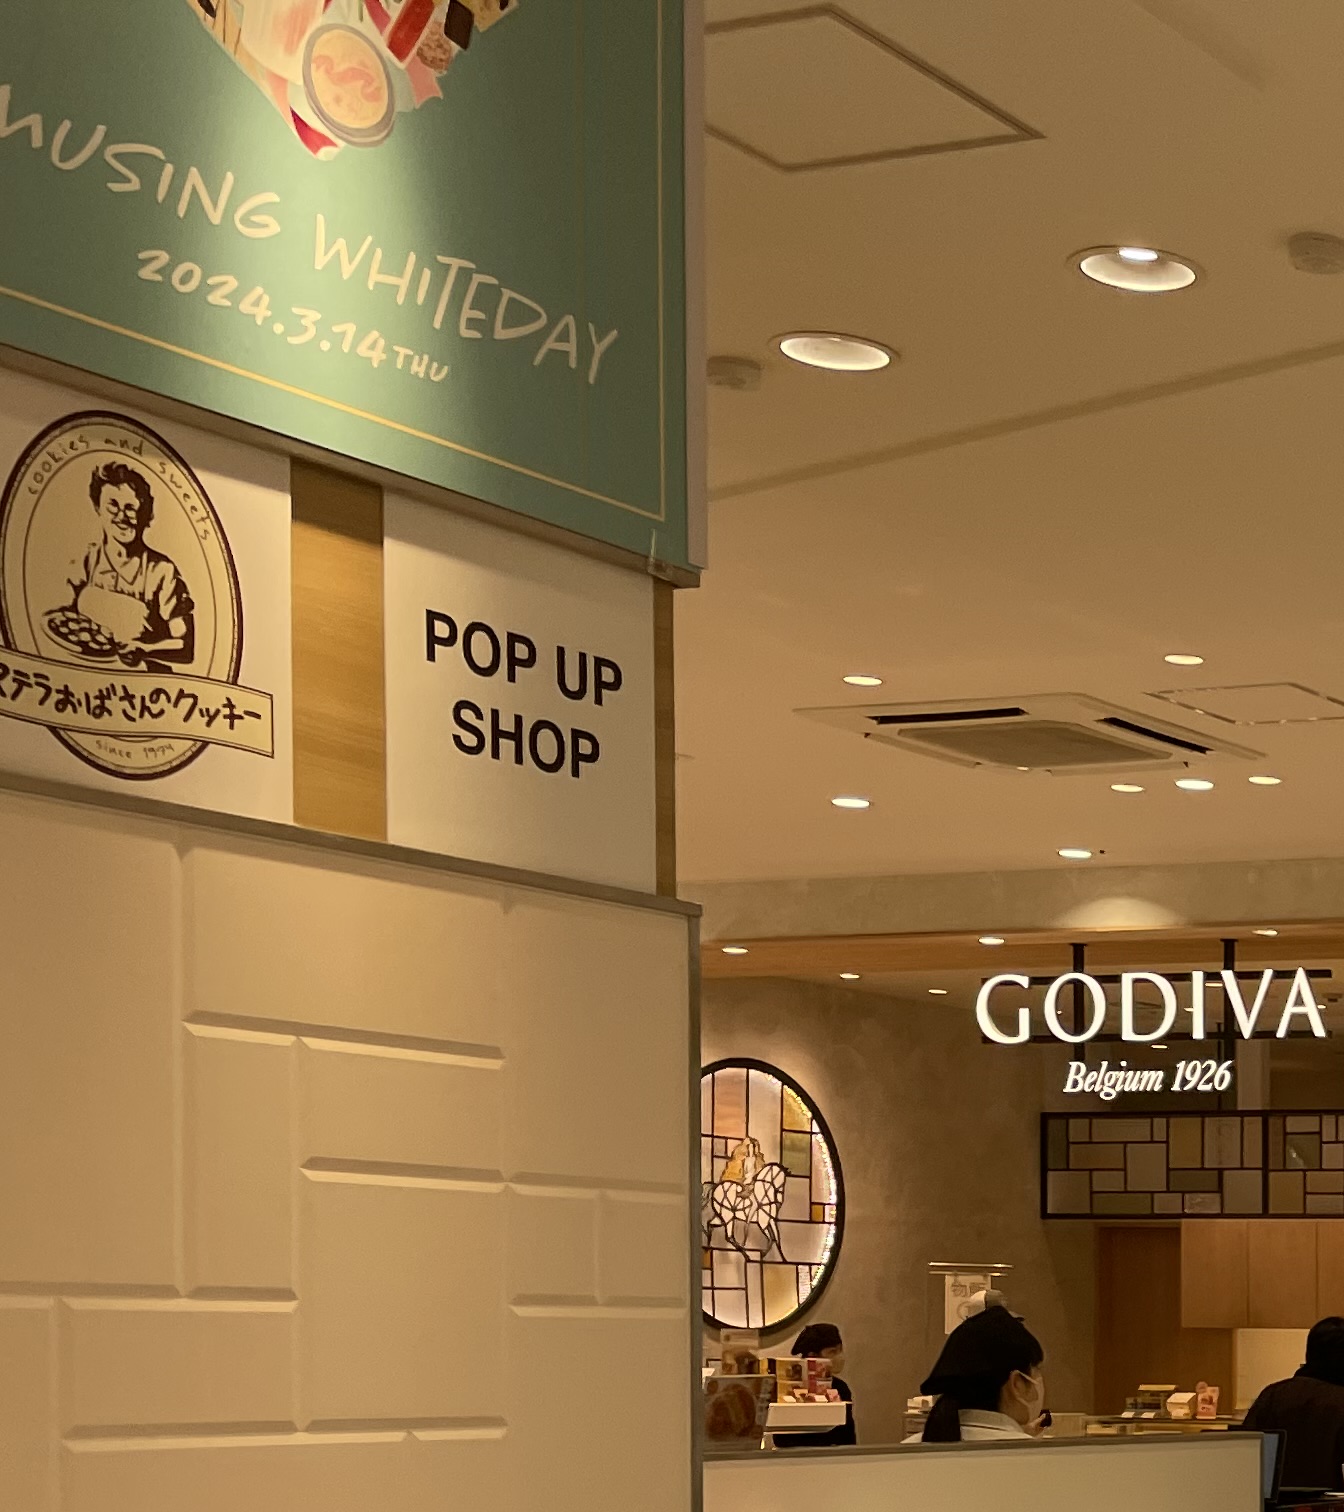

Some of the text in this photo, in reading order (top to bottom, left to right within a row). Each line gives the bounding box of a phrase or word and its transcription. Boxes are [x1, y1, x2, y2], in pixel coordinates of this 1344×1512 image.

[315, 213, 618, 385] WHITEDAY
[26, 432, 211, 541] cookies and sweets
[424, 608, 624, 707] POP UP
[451, 699, 601, 779] SHOP
[976, 966, 1327, 1044] GODIVA
[1063, 1059, 1233, 1101] Belgium 1926
